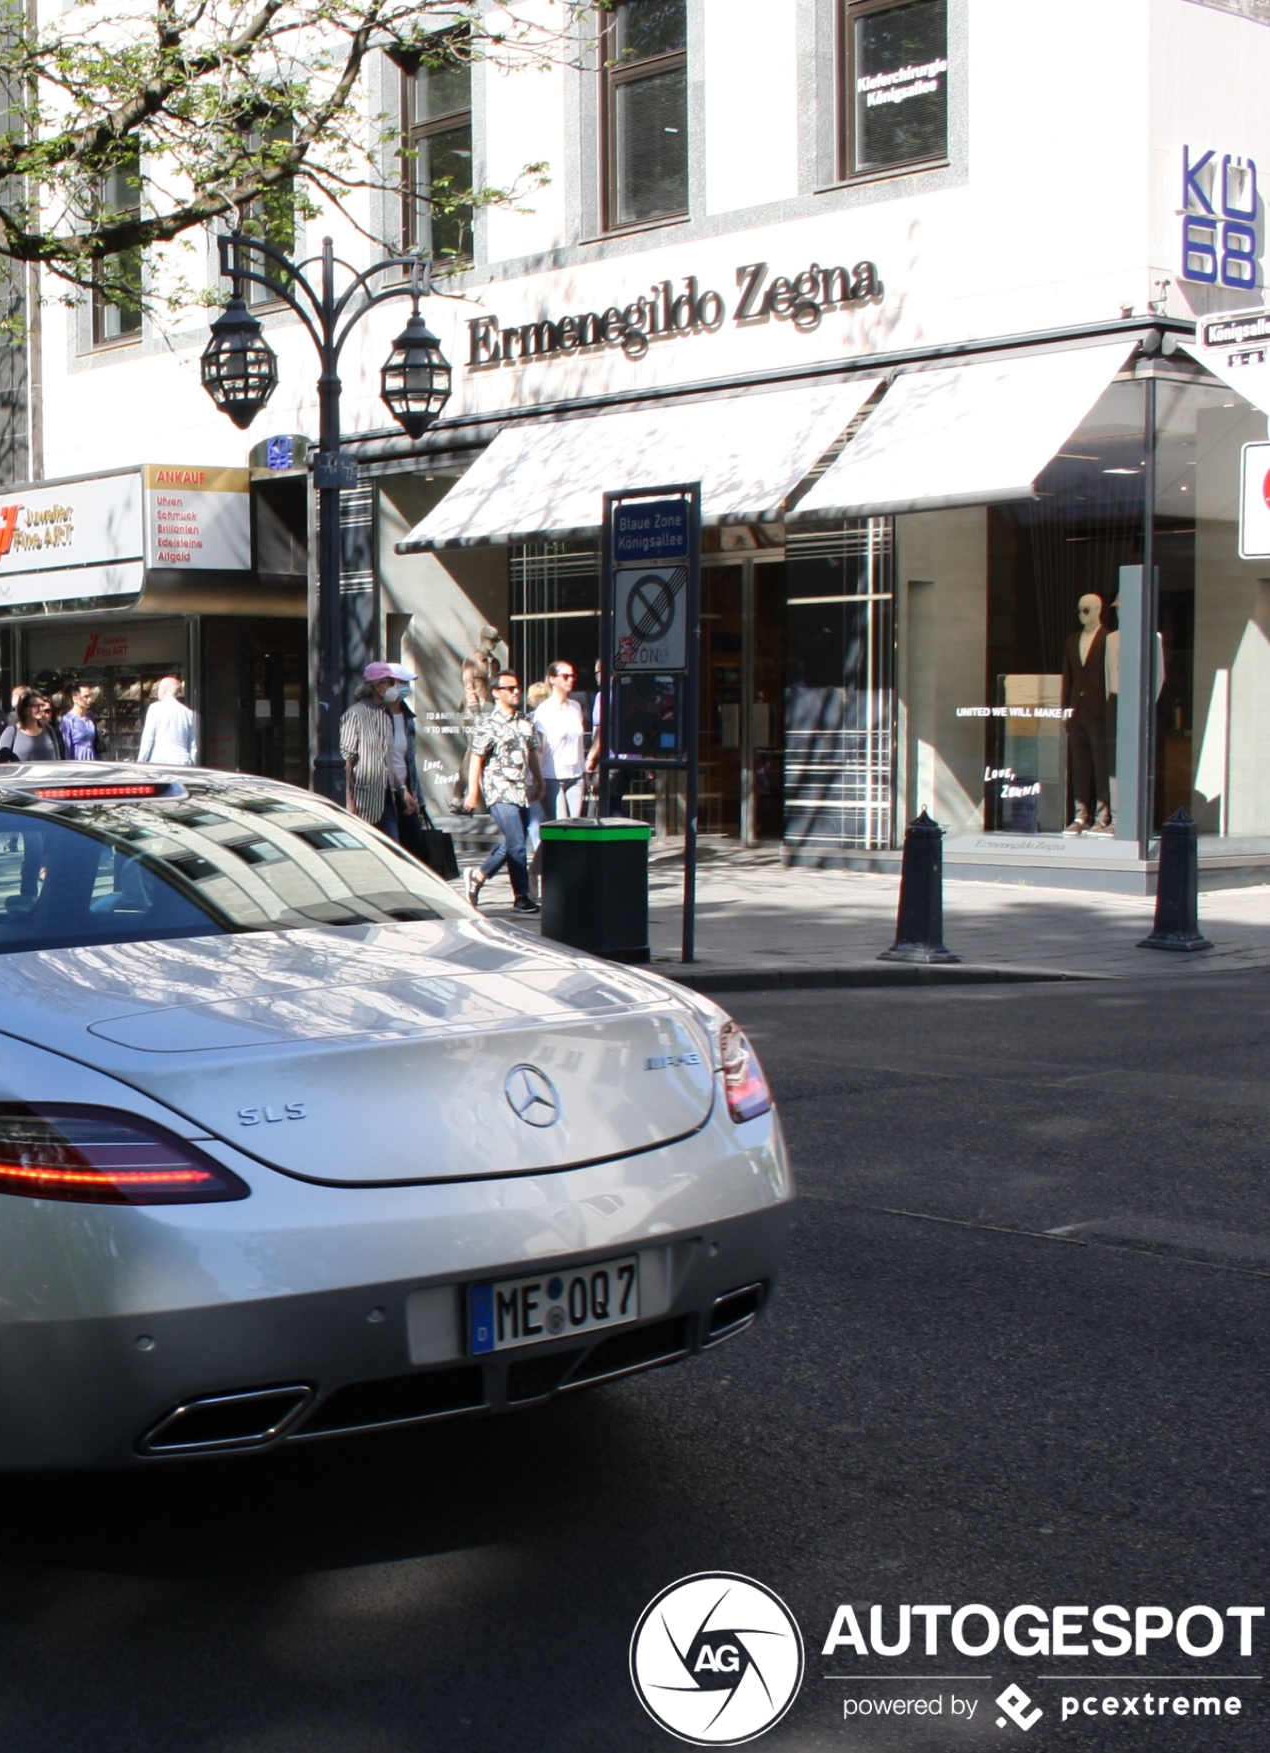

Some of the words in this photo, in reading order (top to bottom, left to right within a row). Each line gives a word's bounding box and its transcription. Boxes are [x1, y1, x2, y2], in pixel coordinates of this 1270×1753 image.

[857, 58, 947, 92] Kieferchirurgie
[866, 80, 938, 107] Königsallee
[1182, 214, 1257, 290] 68
[465, 275, 724, 361] Ermenegildo
[733, 261, 884, 334] Zegna
[1208, 318, 1270, 343] Königsalle
[155, 470, 206, 484] ANKAUF
[156, 496, 183, 507] Uhren
[157, 510, 197, 521] Schmuck
[619, 517, 650, 531] Blaue
[654, 514, 682, 528] Zone
[13, 530, 42, 551] Fine
[44, 523, 74, 548] ART
[157, 524, 199, 535] Brillanten
[157, 537, 203, 549] Edelsteine
[618, 533, 684, 552] Königsallee
[158, 551, 191, 563] Altgold
[113, 645, 128, 655] ART
[956, 707, 991, 717] UNITED
[992, 707, 1008, 717] WE
[1009, 708, 1032, 717] WILL
[1033, 708, 1062, 718] MAKE
[1062, 708, 1074, 719] IT
[431, 726, 440, 734] TO
[1000, 782, 1041, 798] ZEGNA
[974, 839, 1034, 850] Ermenegildo
[1034, 840, 1066, 851] Zegna
[237, 1101, 307, 1127] SLS
[496, 1283, 544, 1342] ME
[568, 1270, 610, 1327] OQ
[617, 1263, 635, 1316] 7
[477, 1326, 489, 1341] D
